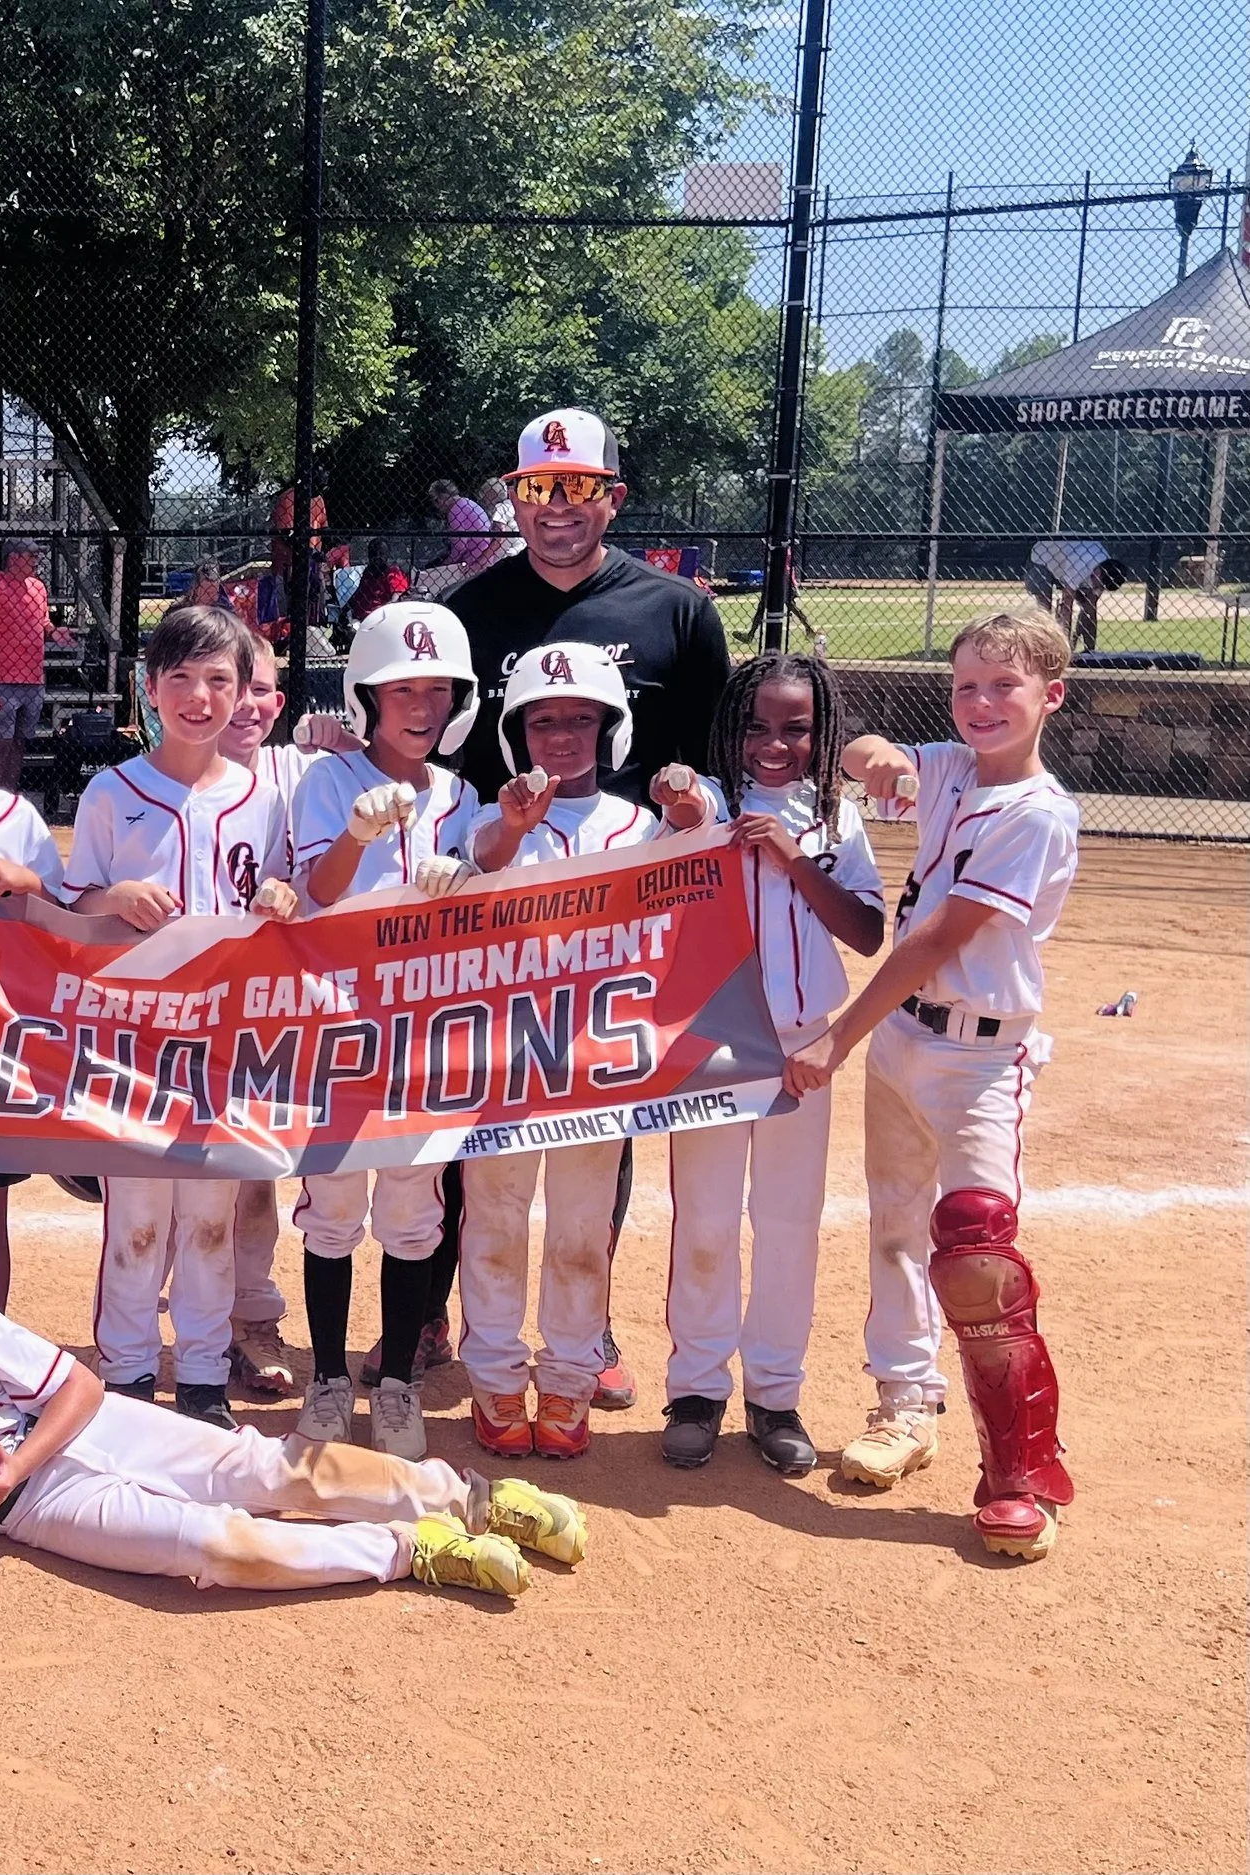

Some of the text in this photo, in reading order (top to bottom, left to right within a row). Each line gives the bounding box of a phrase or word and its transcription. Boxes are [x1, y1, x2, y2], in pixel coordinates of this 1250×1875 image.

[636, 857, 724, 904] LAUNCH
[646, 889, 716, 911] HYDRATE
[376, 883, 612, 948] WIN THE MOMENT
[50, 913, 672, 1031] PERFECT GAME TOURNAMENT
